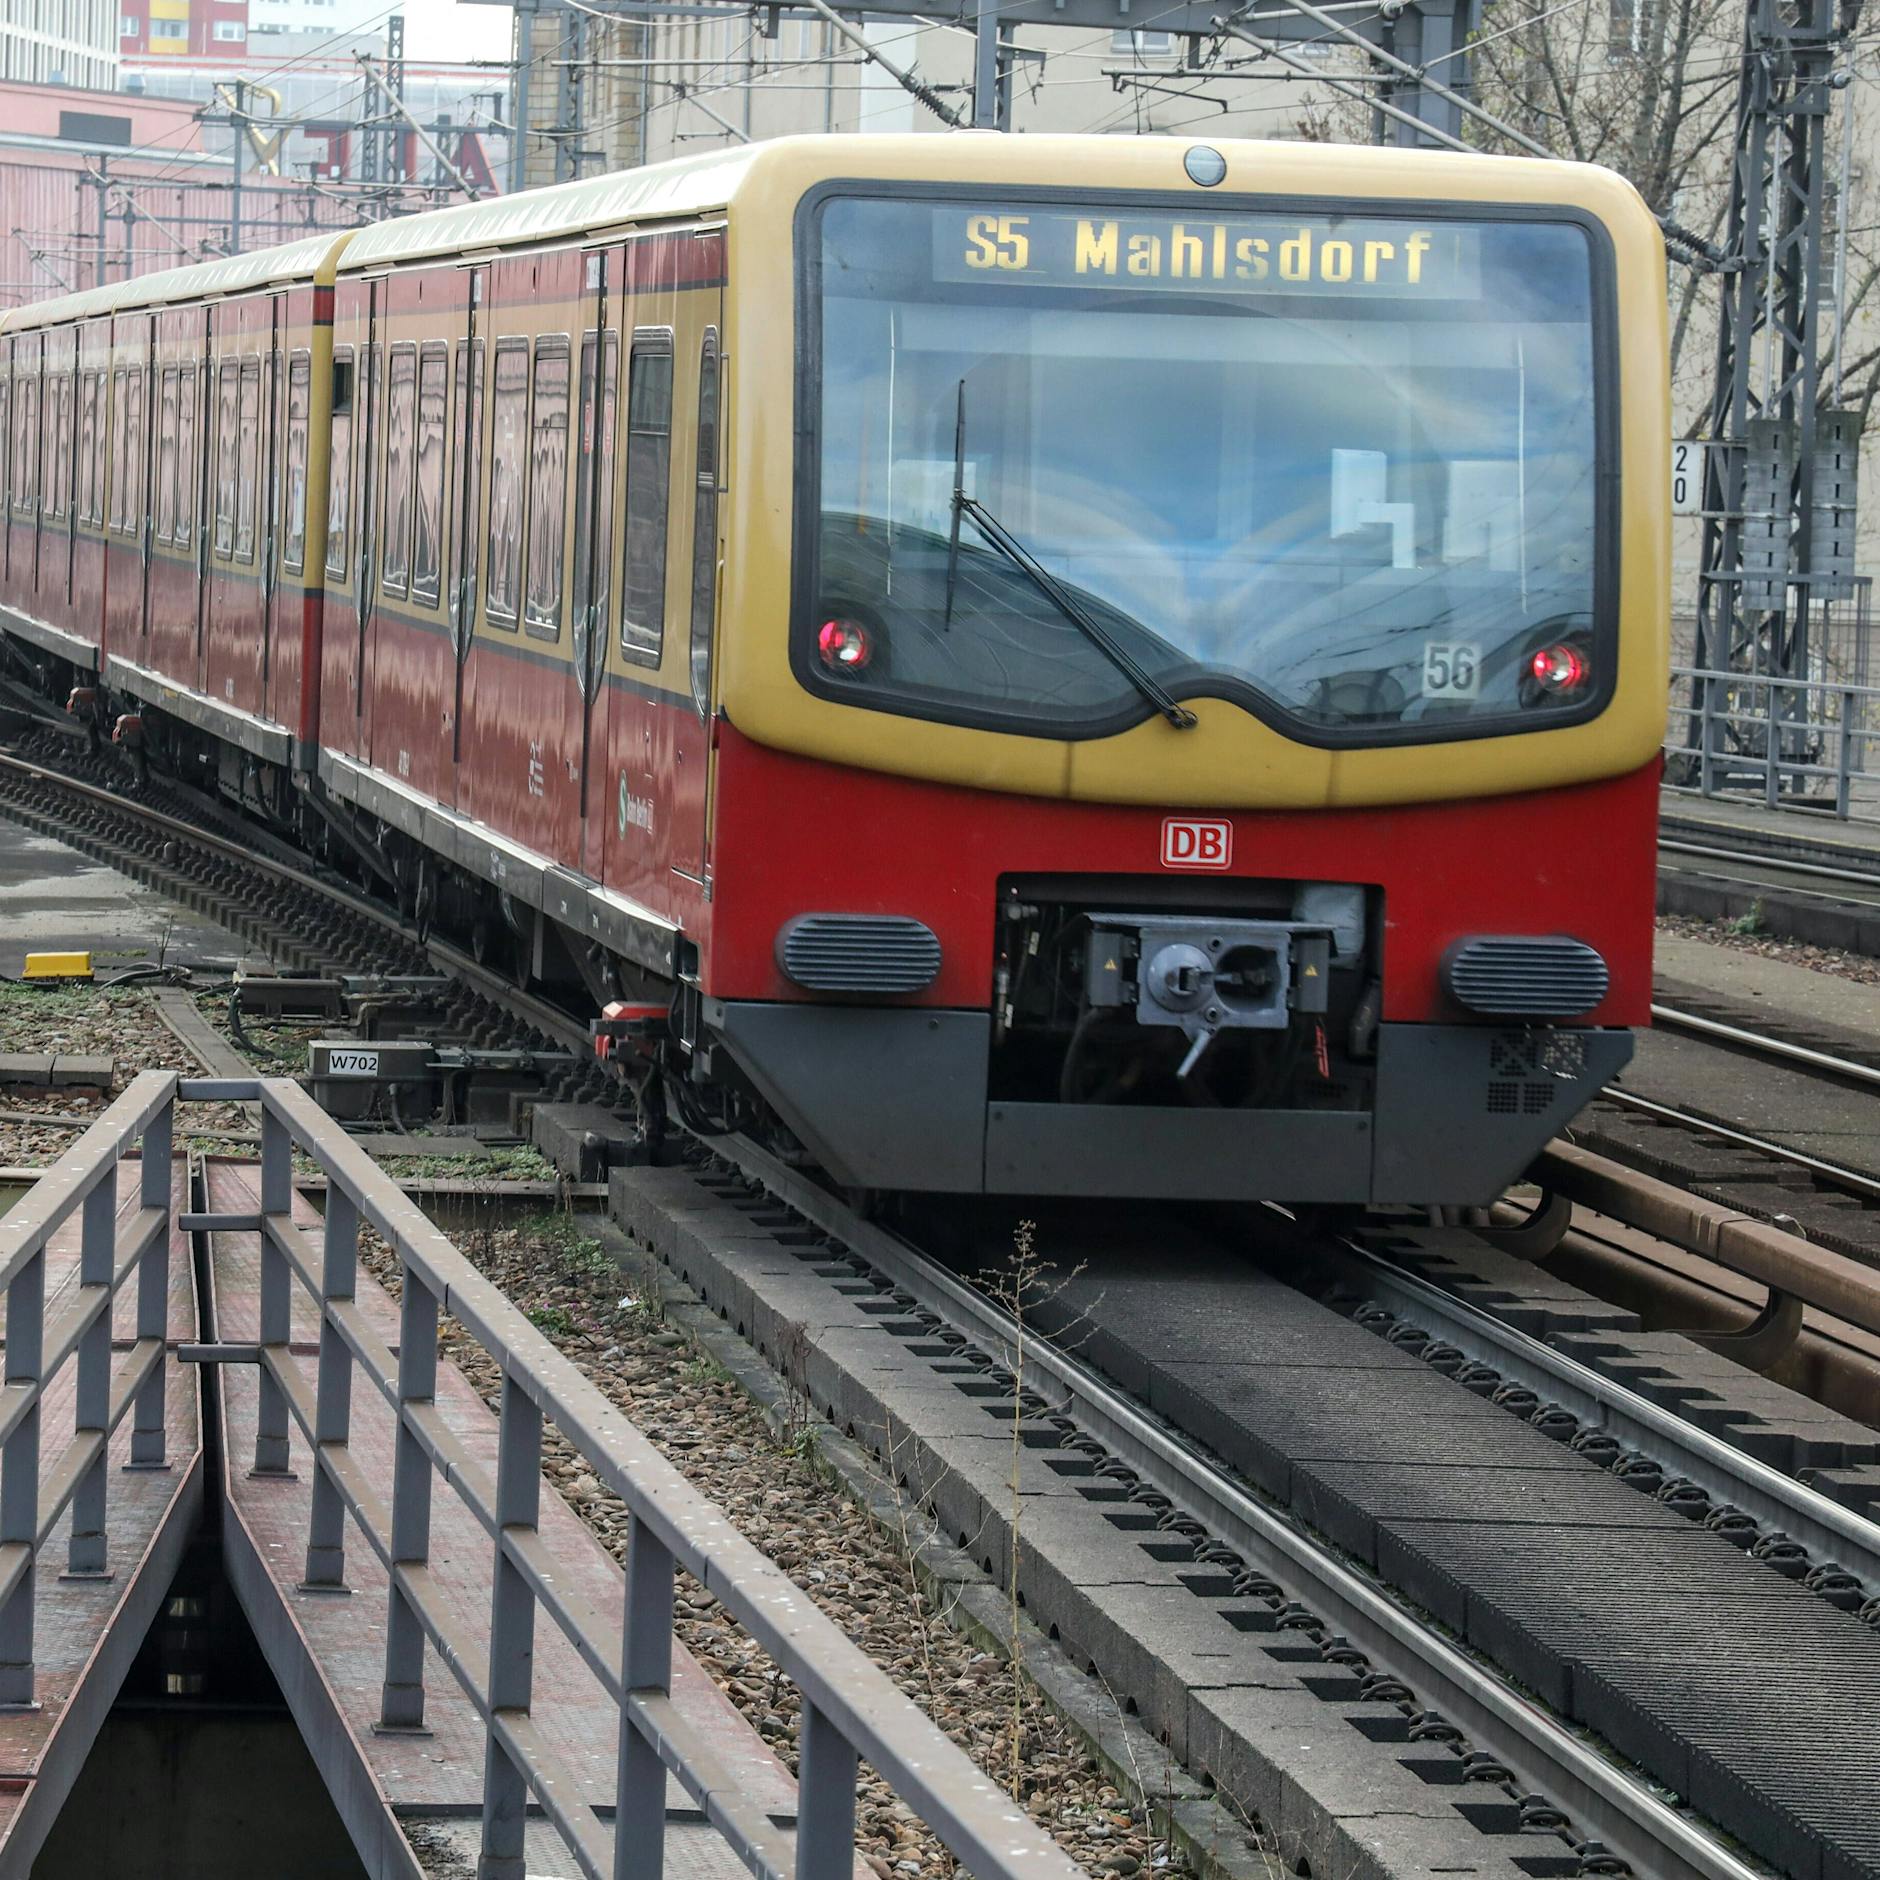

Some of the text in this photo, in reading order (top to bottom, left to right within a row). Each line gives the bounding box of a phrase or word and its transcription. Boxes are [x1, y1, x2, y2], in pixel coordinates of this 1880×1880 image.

[965, 215, 1432, 284] S5 Mahlsdorf
[1427, 646, 1475, 691] 56
[1170, 824, 1224, 861] DB
[331, 1055, 378, 1072] W702
